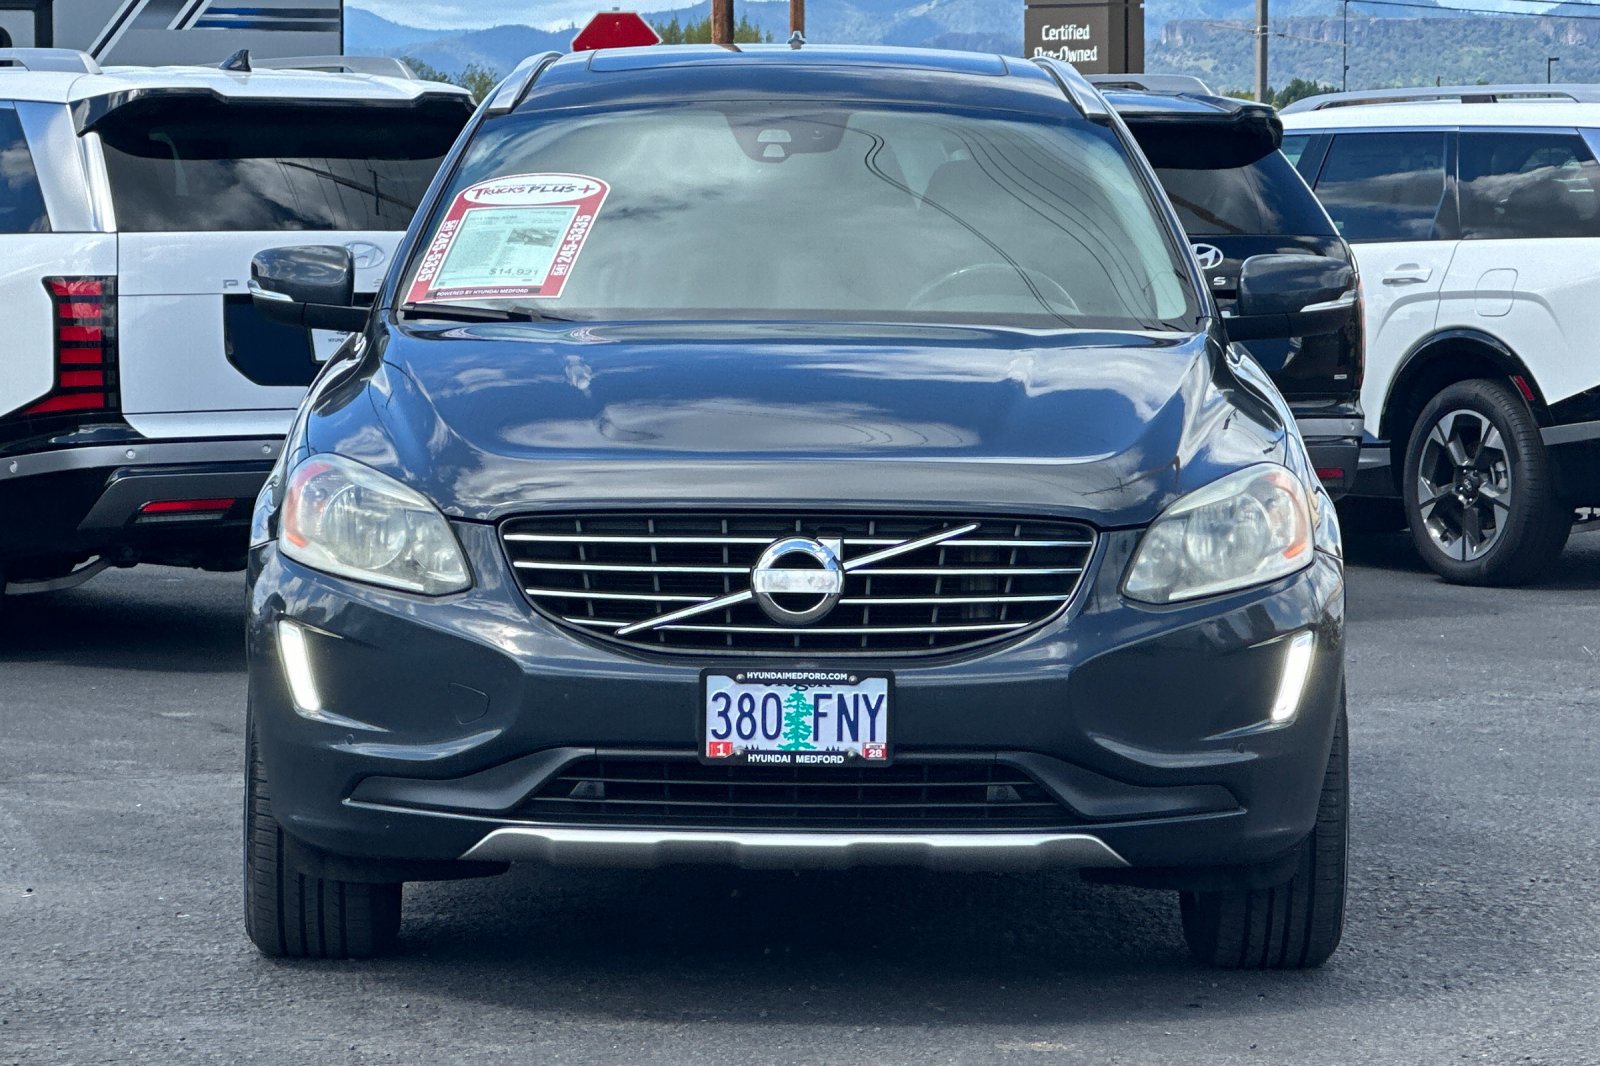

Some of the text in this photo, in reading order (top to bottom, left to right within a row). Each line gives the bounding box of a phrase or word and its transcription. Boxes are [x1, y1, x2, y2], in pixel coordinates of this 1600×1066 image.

[1041, 24, 1090, 41] Certified
[472, 186, 525, 199] TRUCKS
[556, 214, 592, 263] 245-5335
[417, 230, 453, 282] 245-5335
[747, 671, 848, 681] HYUNDAIMEDFORD.COM
[711, 691, 885, 742] 380 FNY
[716, 743, 727, 756] 1
[868, 749, 883, 758] 28
[747, 753, 844, 764] HYUNDAI MEDFORD
